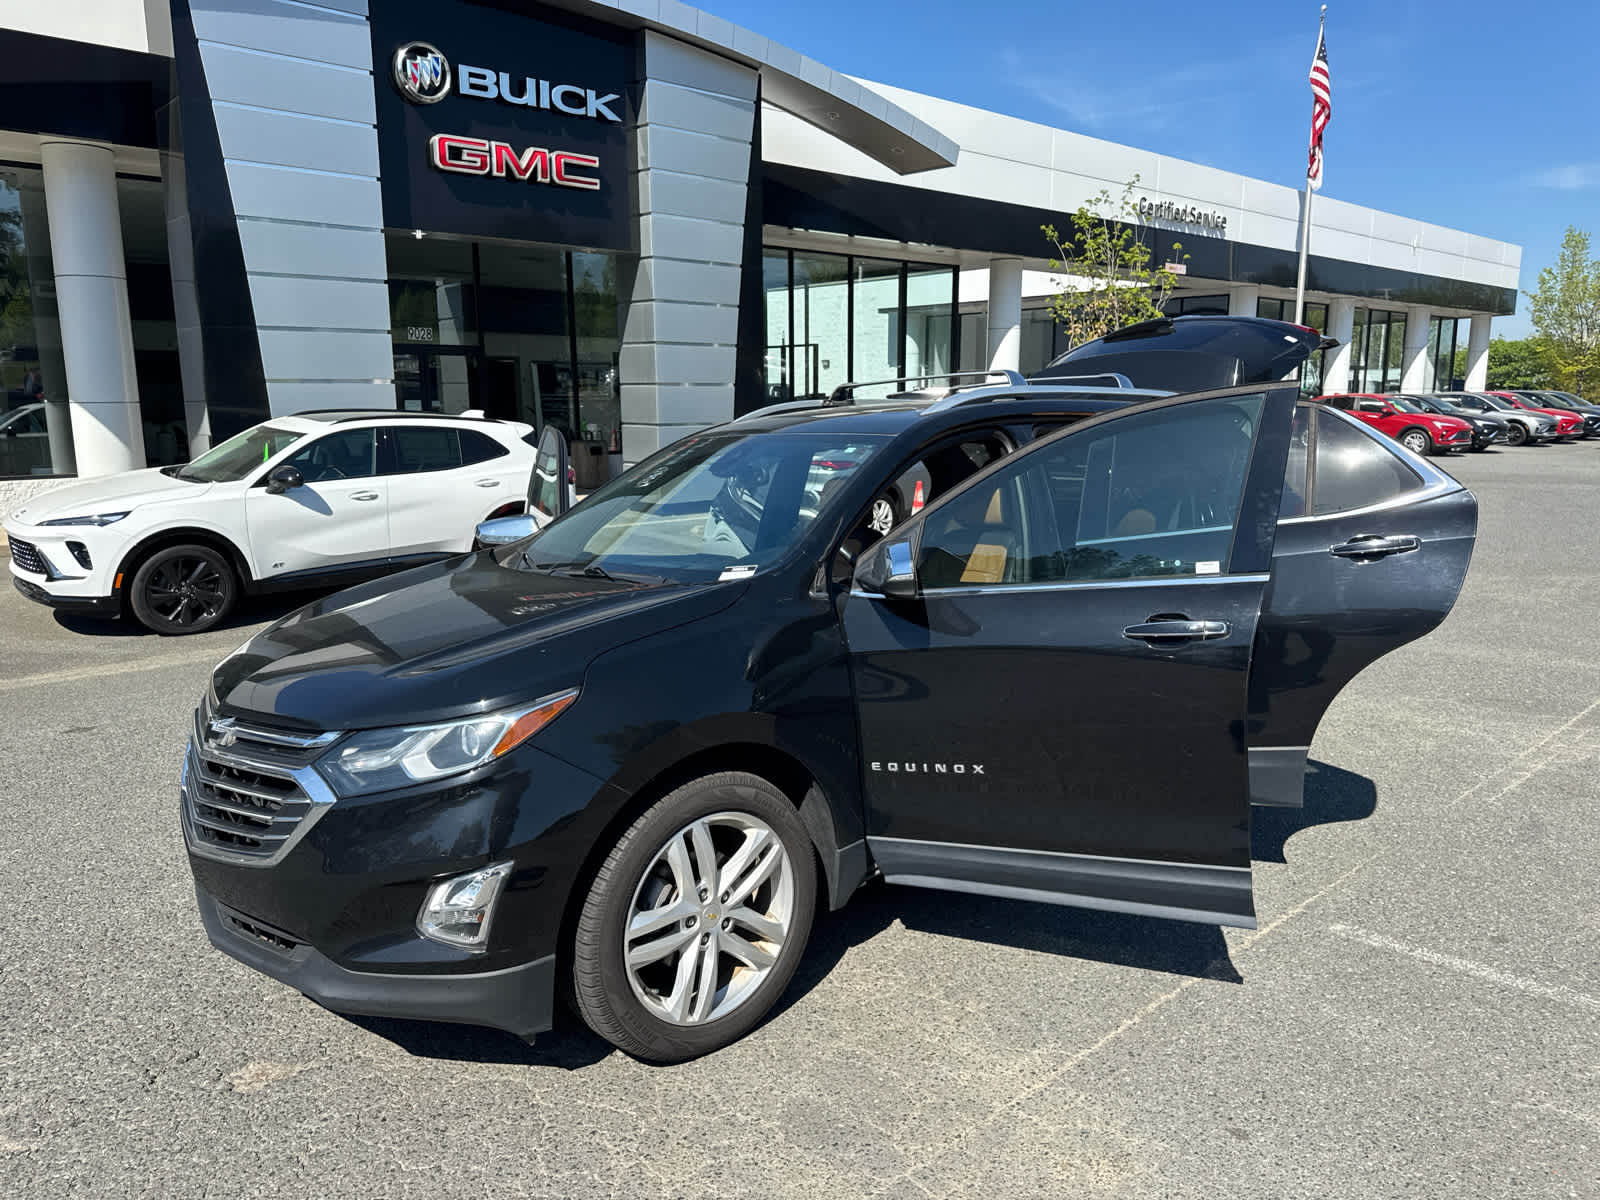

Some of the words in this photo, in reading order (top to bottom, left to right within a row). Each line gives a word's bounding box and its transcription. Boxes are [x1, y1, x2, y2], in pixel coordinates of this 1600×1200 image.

[458, 64, 622, 122] BUICK
[429, 133, 600, 190] GMC
[1139, 197, 1188, 222] Certified
[1190, 206, 1227, 229] Service
[408, 327, 433, 340] 9028
[871, 762, 985, 774] EQUINOX
